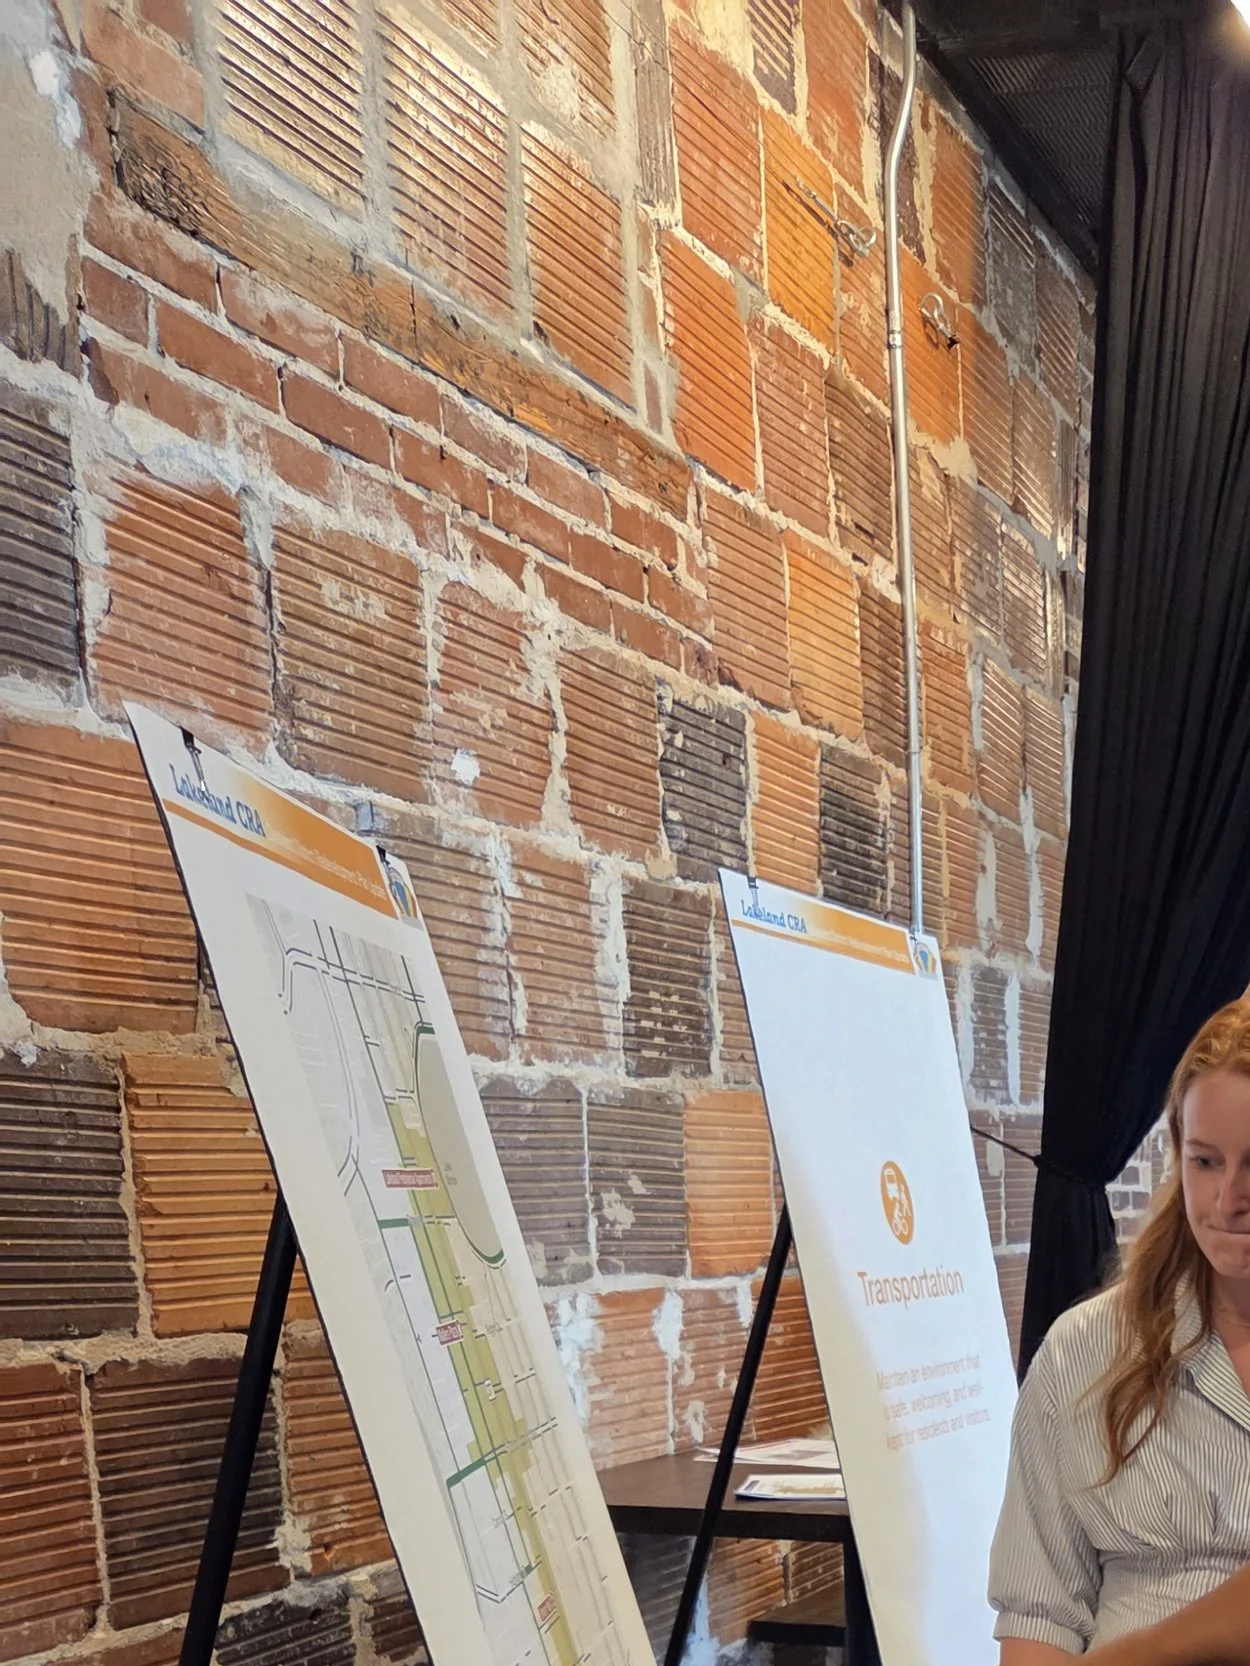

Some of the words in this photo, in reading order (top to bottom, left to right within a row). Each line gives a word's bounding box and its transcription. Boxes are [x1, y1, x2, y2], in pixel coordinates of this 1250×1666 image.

[236, 800, 266, 838] CRA
[787, 914, 807, 934] CRA
[857, 1264, 965, 1310] Transportation
[876, 1370, 910, 1391] Maintain
[921, 1358, 966, 1381] environment
[917, 1420, 950, 1441] residents
